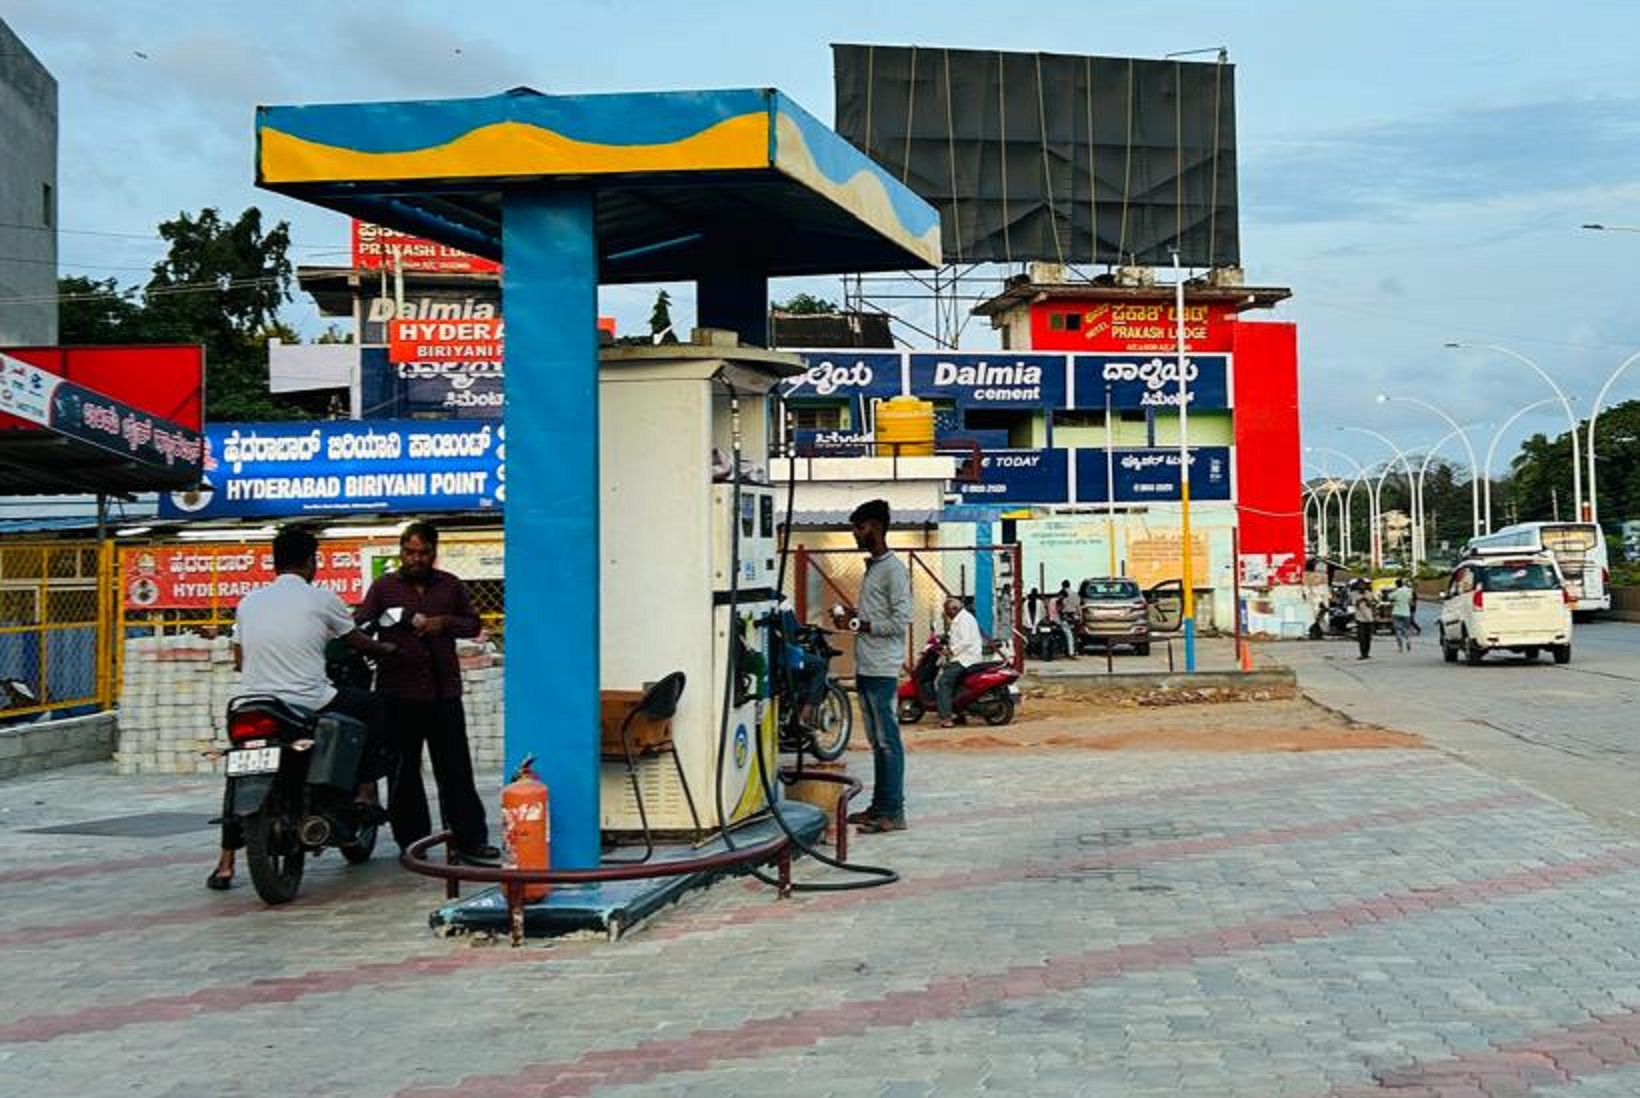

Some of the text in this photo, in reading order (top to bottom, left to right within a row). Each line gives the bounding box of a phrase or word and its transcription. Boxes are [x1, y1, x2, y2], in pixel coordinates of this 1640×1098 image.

[369, 298, 495, 322] Dalmia
[1112, 326, 1165, 339] PRAKASH
[417, 345, 493, 357] BIRIYANI
[934, 361, 1042, 385] Dalmia
[974, 386, 1041, 400] cement
[996, 456, 1040, 467] TODAY
[226, 471, 488, 500] HYDERABAD BIRIYANI POINT
